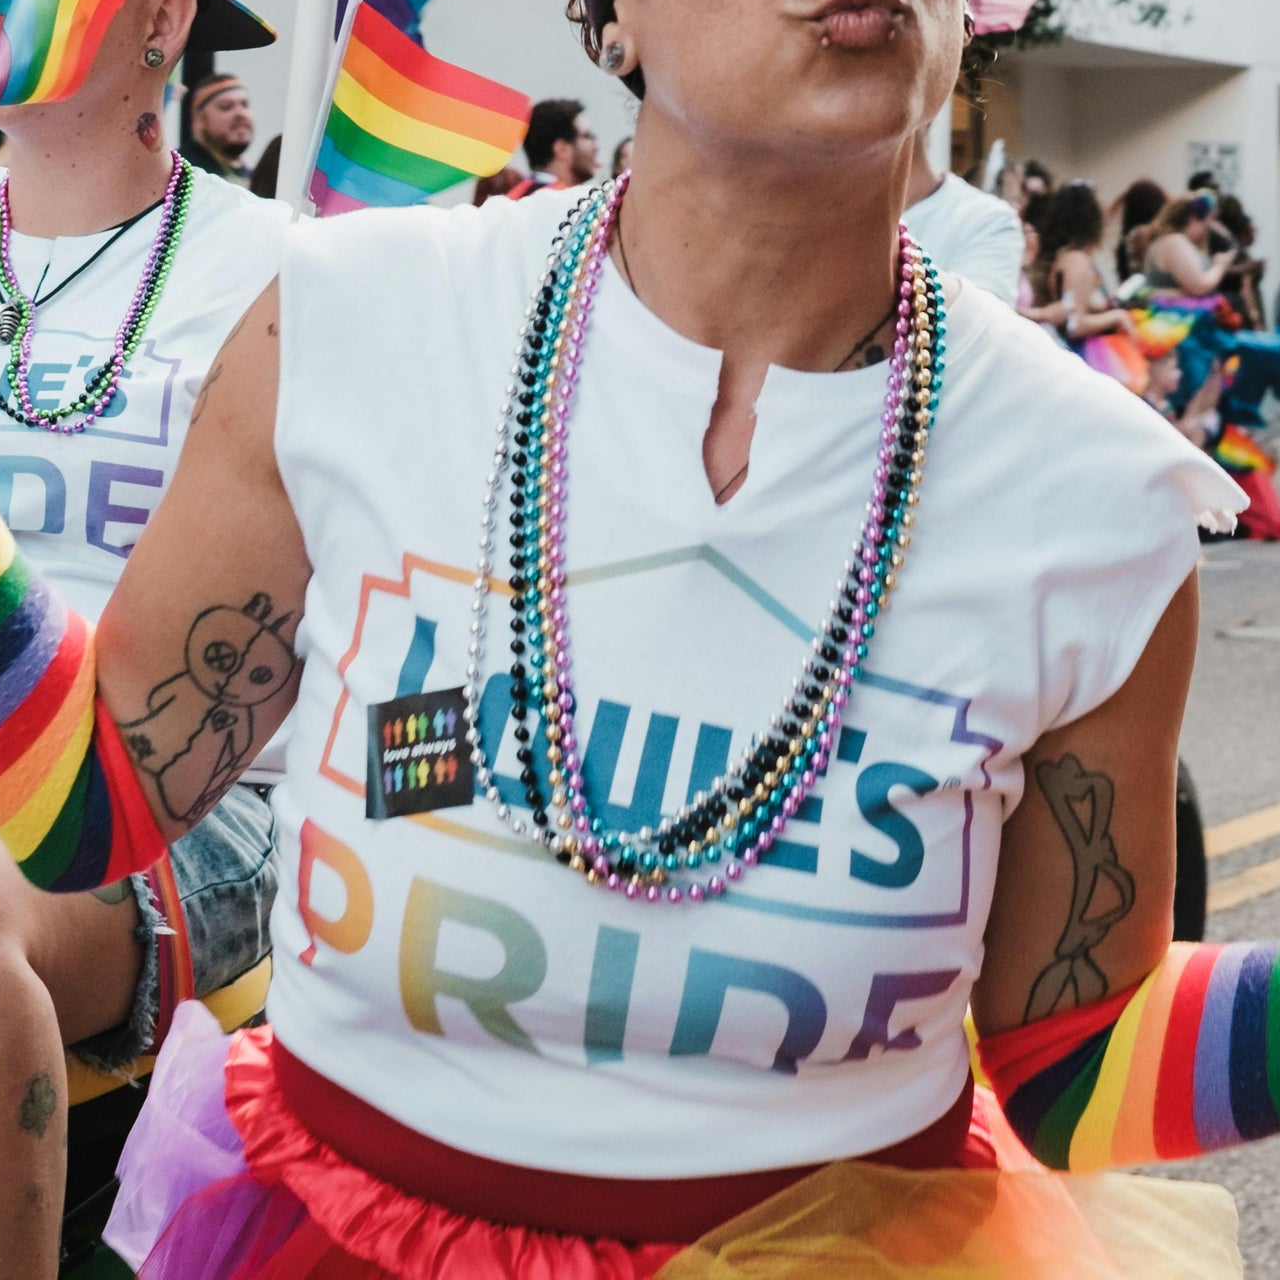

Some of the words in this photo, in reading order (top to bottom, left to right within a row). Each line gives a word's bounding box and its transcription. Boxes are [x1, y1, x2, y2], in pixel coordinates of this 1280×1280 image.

[383, 747, 411, 764] love
[410, 738, 457, 758] always
[298, 816, 964, 1075] PRIDE
